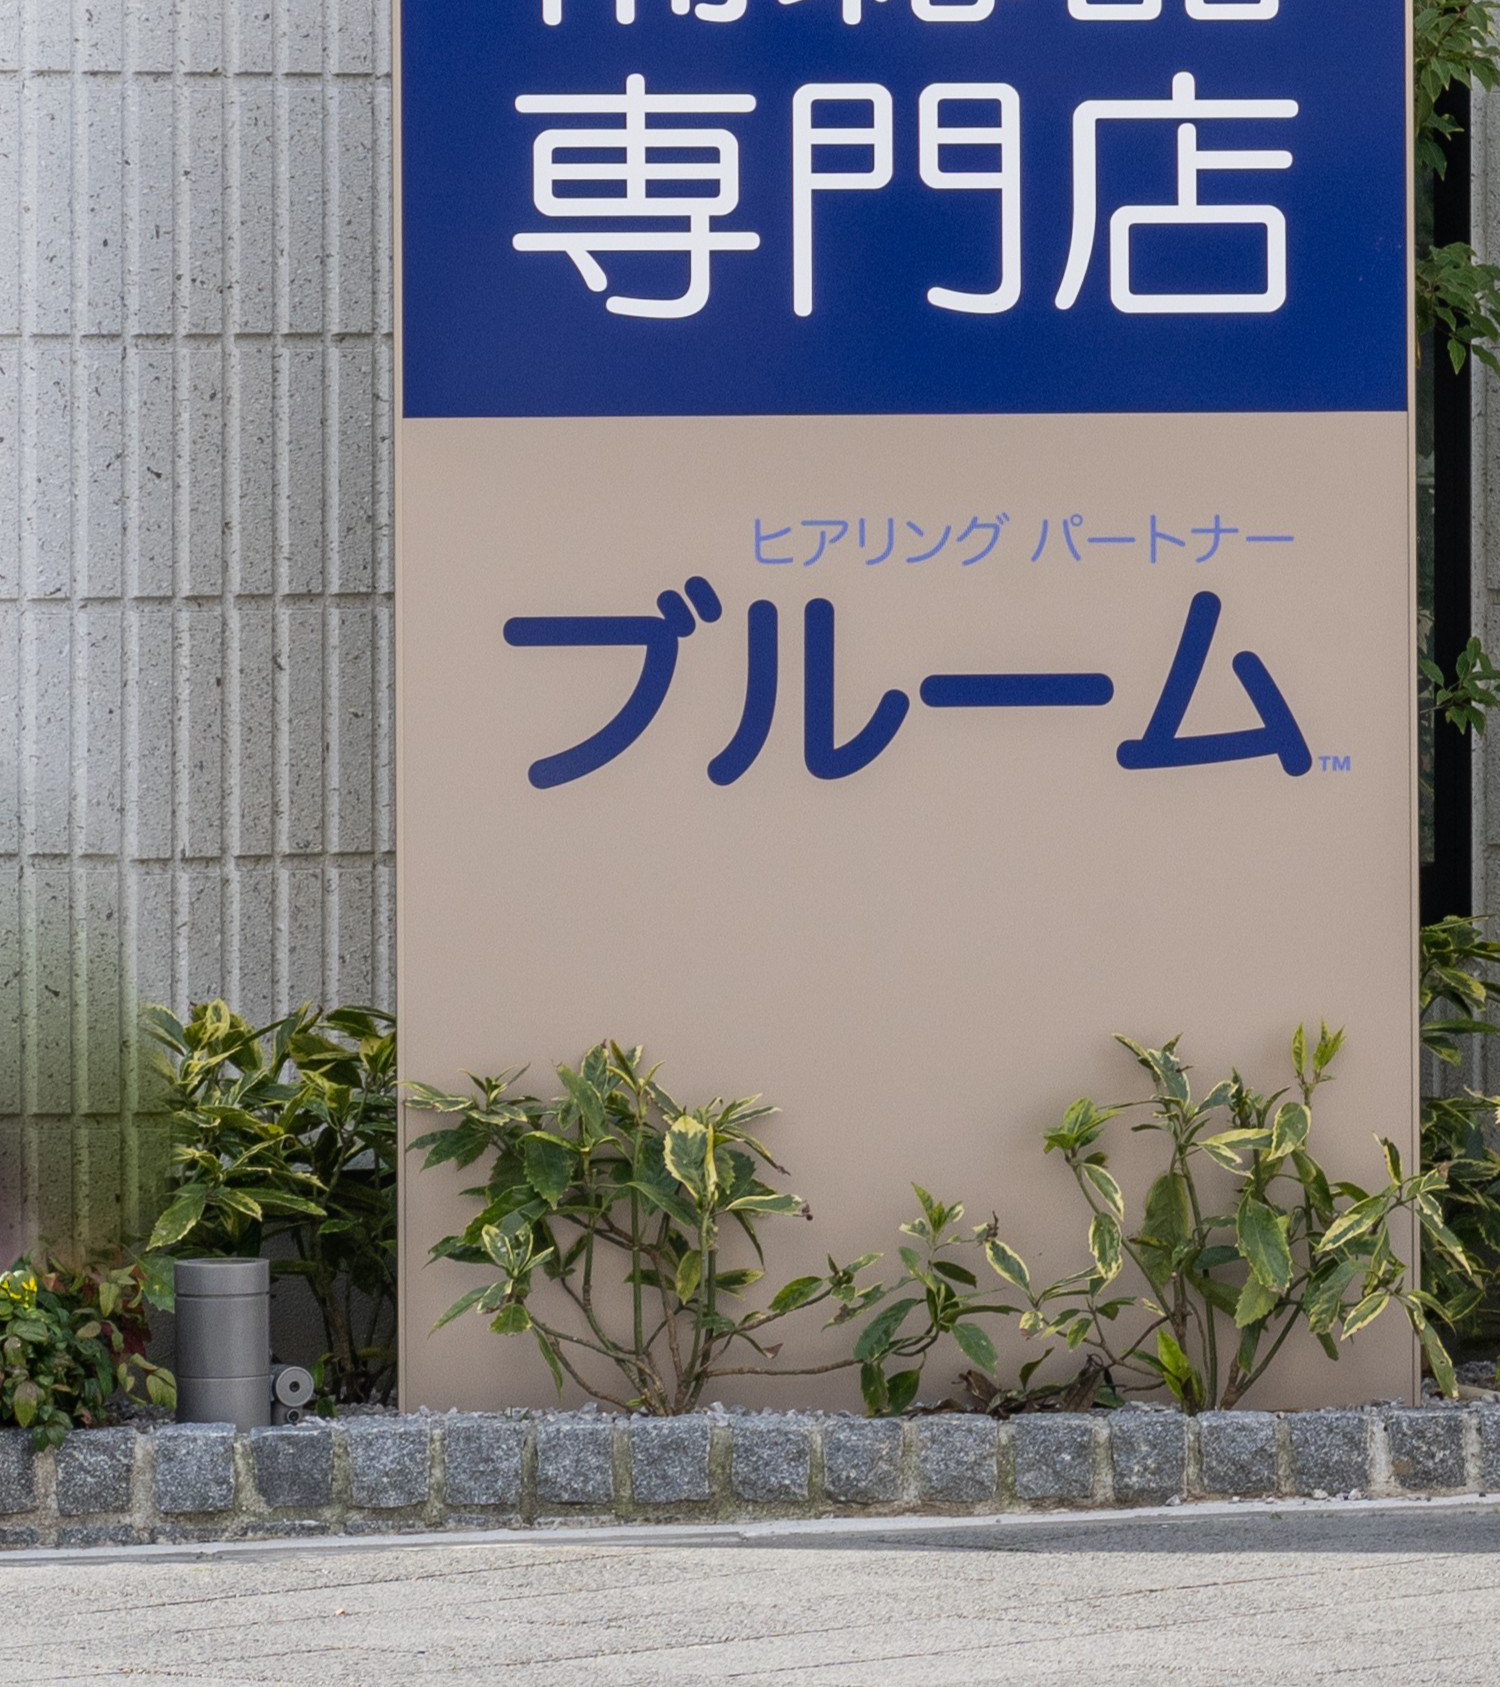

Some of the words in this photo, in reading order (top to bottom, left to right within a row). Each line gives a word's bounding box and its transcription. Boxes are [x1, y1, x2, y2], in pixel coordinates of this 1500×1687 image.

[512, 71, 1299, 319] 専門店
[753, 512, 1010, 567] ヒアリング
[1030, 513, 1295, 565] パートナー
[503, 575, 1313, 790] ブルーム
